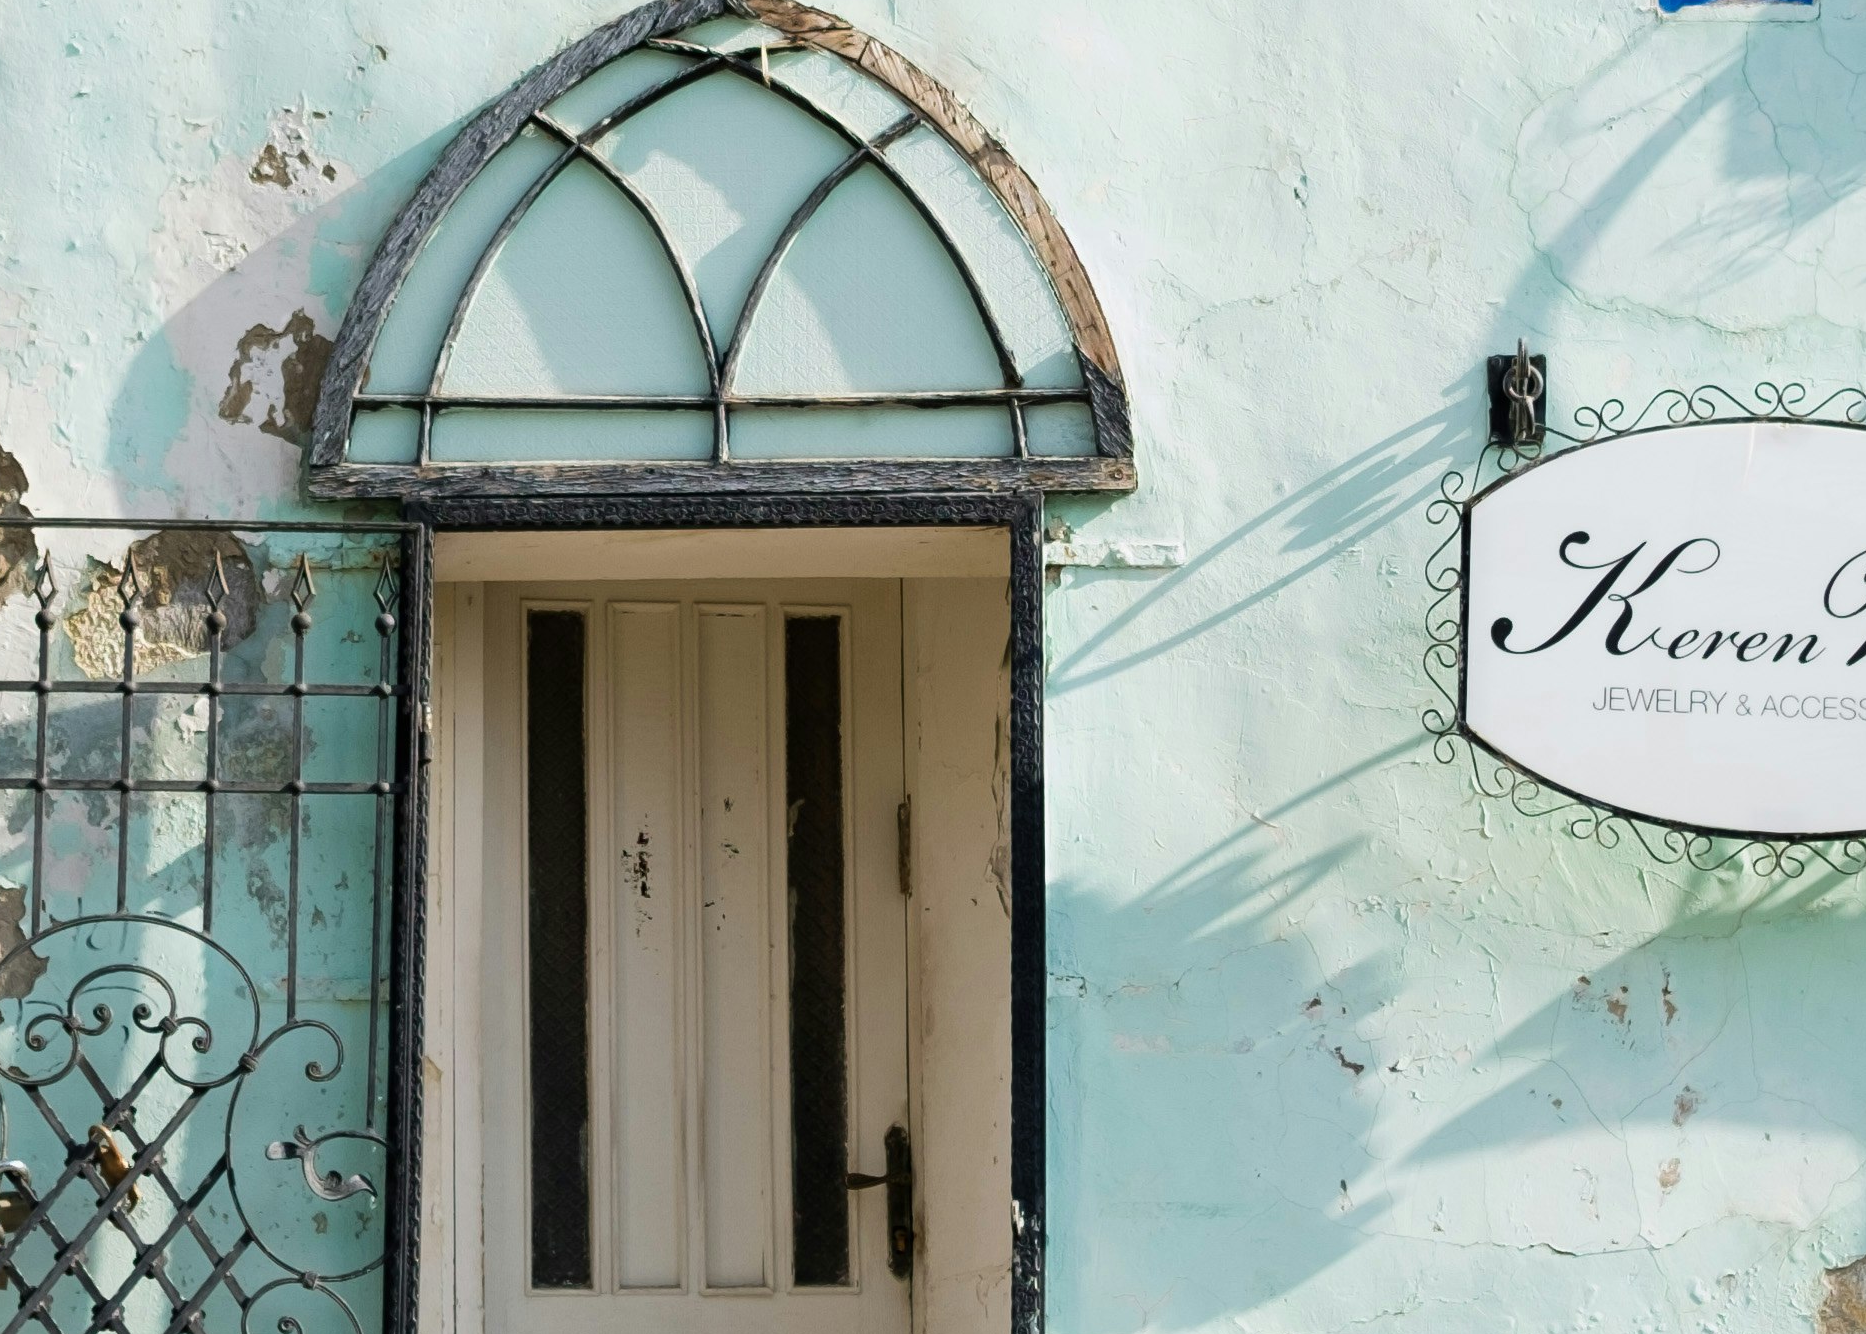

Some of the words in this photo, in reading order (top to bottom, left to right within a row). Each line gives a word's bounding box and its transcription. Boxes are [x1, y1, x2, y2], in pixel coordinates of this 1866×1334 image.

[1490, 530, 1824, 665] Keren
[1592, 687, 1728, 716] JEWELRY
[1735, 693, 1752, 717] &
